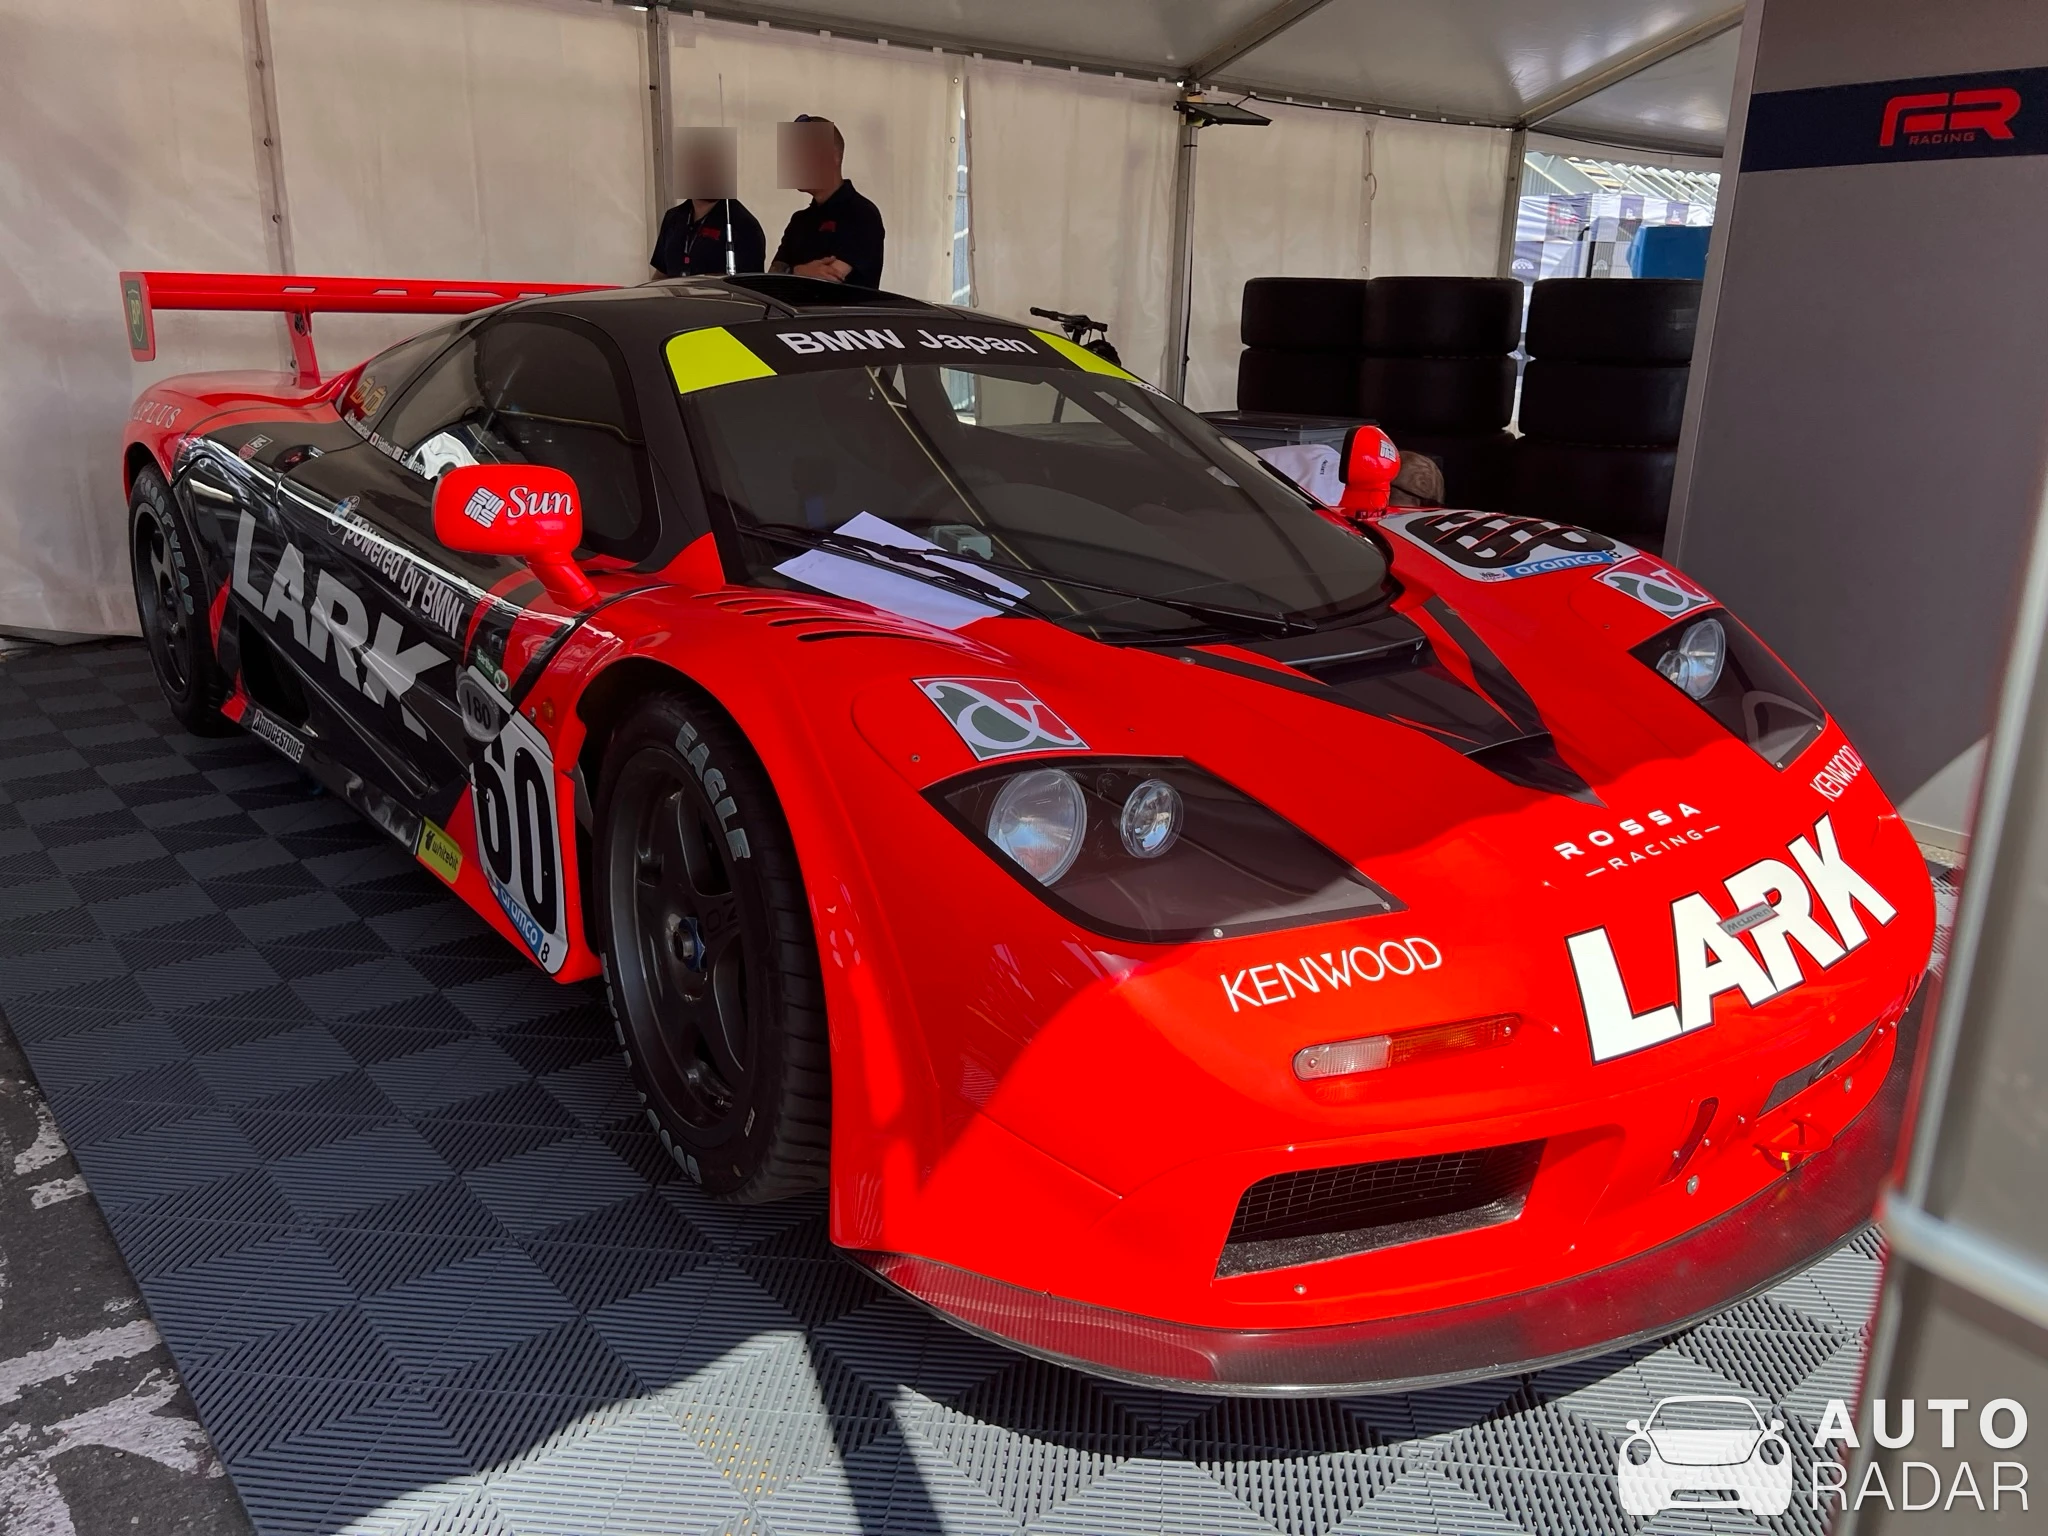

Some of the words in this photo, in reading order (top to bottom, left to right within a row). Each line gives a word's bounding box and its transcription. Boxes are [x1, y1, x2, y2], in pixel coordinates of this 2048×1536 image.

[1909, 132, 1976, 145] RACING
[776, 329, 905, 354] BMW
[917, 329, 1039, 355] Japan
[507, 486, 574, 518] Sun
[341, 520, 405, 583] powered
[399, 561, 424, 608] by
[420, 576, 465, 640] BMW
[1514, 554, 1603, 575] aramco
[232, 508, 451, 742] LARK
[252, 709, 305, 764] BRIDGESTONE
[675, 721, 751, 862] EAGLE
[1809, 744, 1863, 803] KENWOOD
[431, 840, 459, 872] whitebit
[1554, 803, 1701, 861] ROSSA
[1607, 829, 1704, 870] RACING
[499, 886, 539, 946] aramco
[540, 942, 551, 964] 8
[1564, 810, 1899, 1066] LARK
[1219, 936, 1443, 1013] KENWOOD
